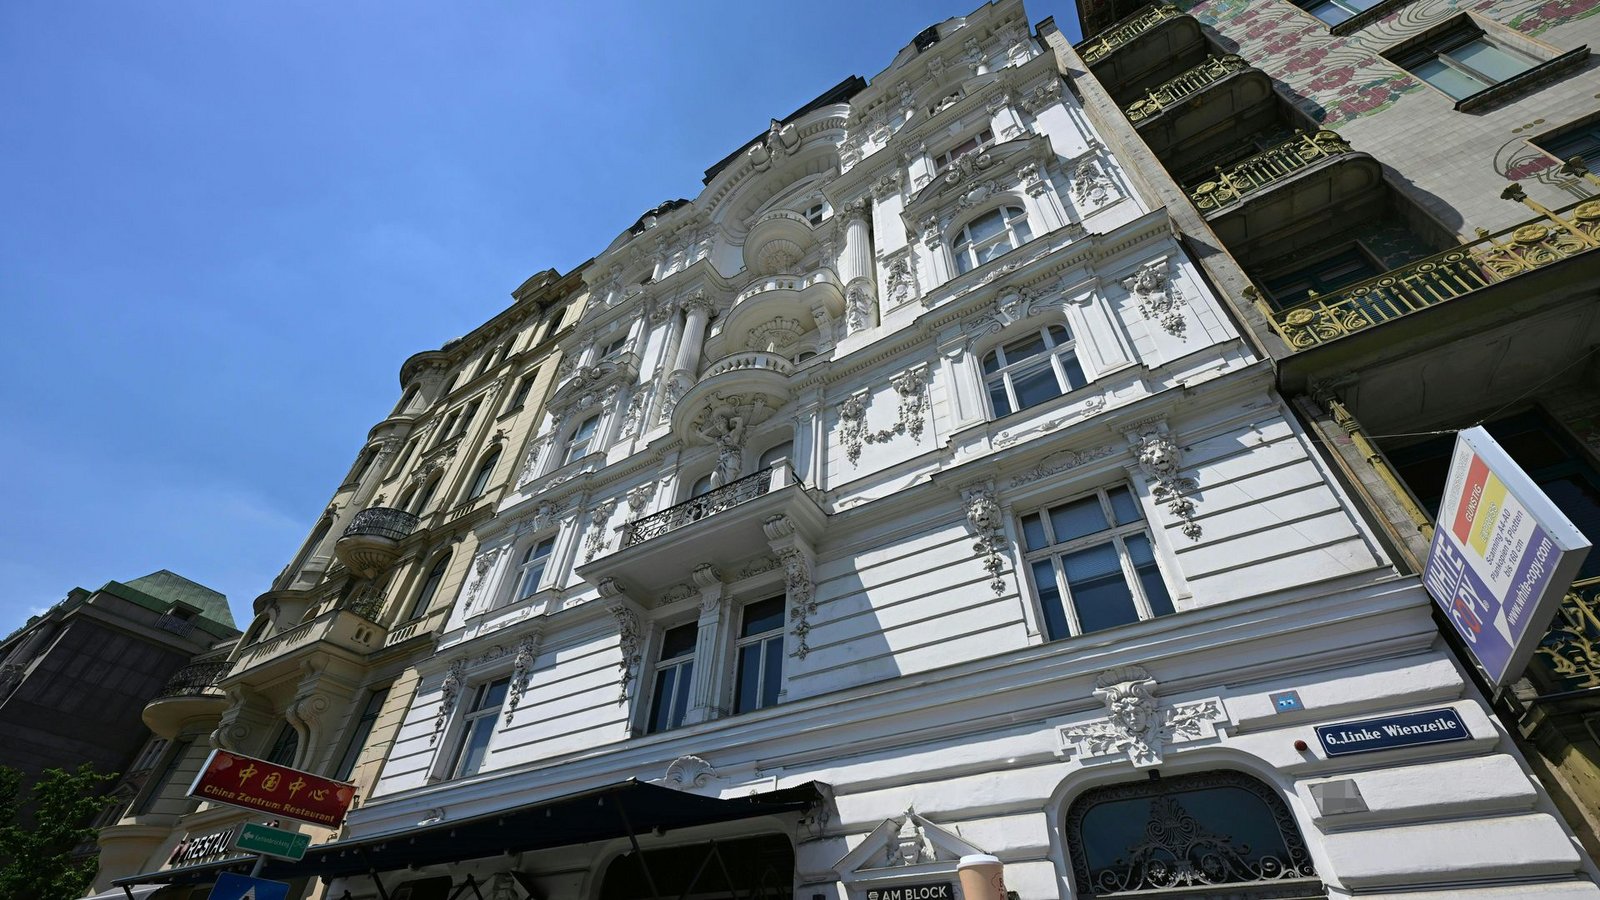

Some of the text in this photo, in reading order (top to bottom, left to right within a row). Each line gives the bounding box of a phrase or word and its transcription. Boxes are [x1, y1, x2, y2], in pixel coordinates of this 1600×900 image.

[1479, 502, 1498, 543] EXPRESS
[1486, 508, 1511, 566] Scanning A4-A0
[1490, 510, 1523, 583] Plankopien & Plotten
[1504, 539, 1524, 577] bis 160 cm
[1427, 533, 1463, 606] WHITE
[1507, 536, 1553, 626] www.white-copy.com
[1340, 728, 1381, 743] Linke
[1382, 718, 1457, 737] Wienzeile
[239, 763, 330, 801] 中国中心
[204, 784, 335, 823] China Zentrum Restaurant
[882, 886, 947, 900] AM BLOCK
